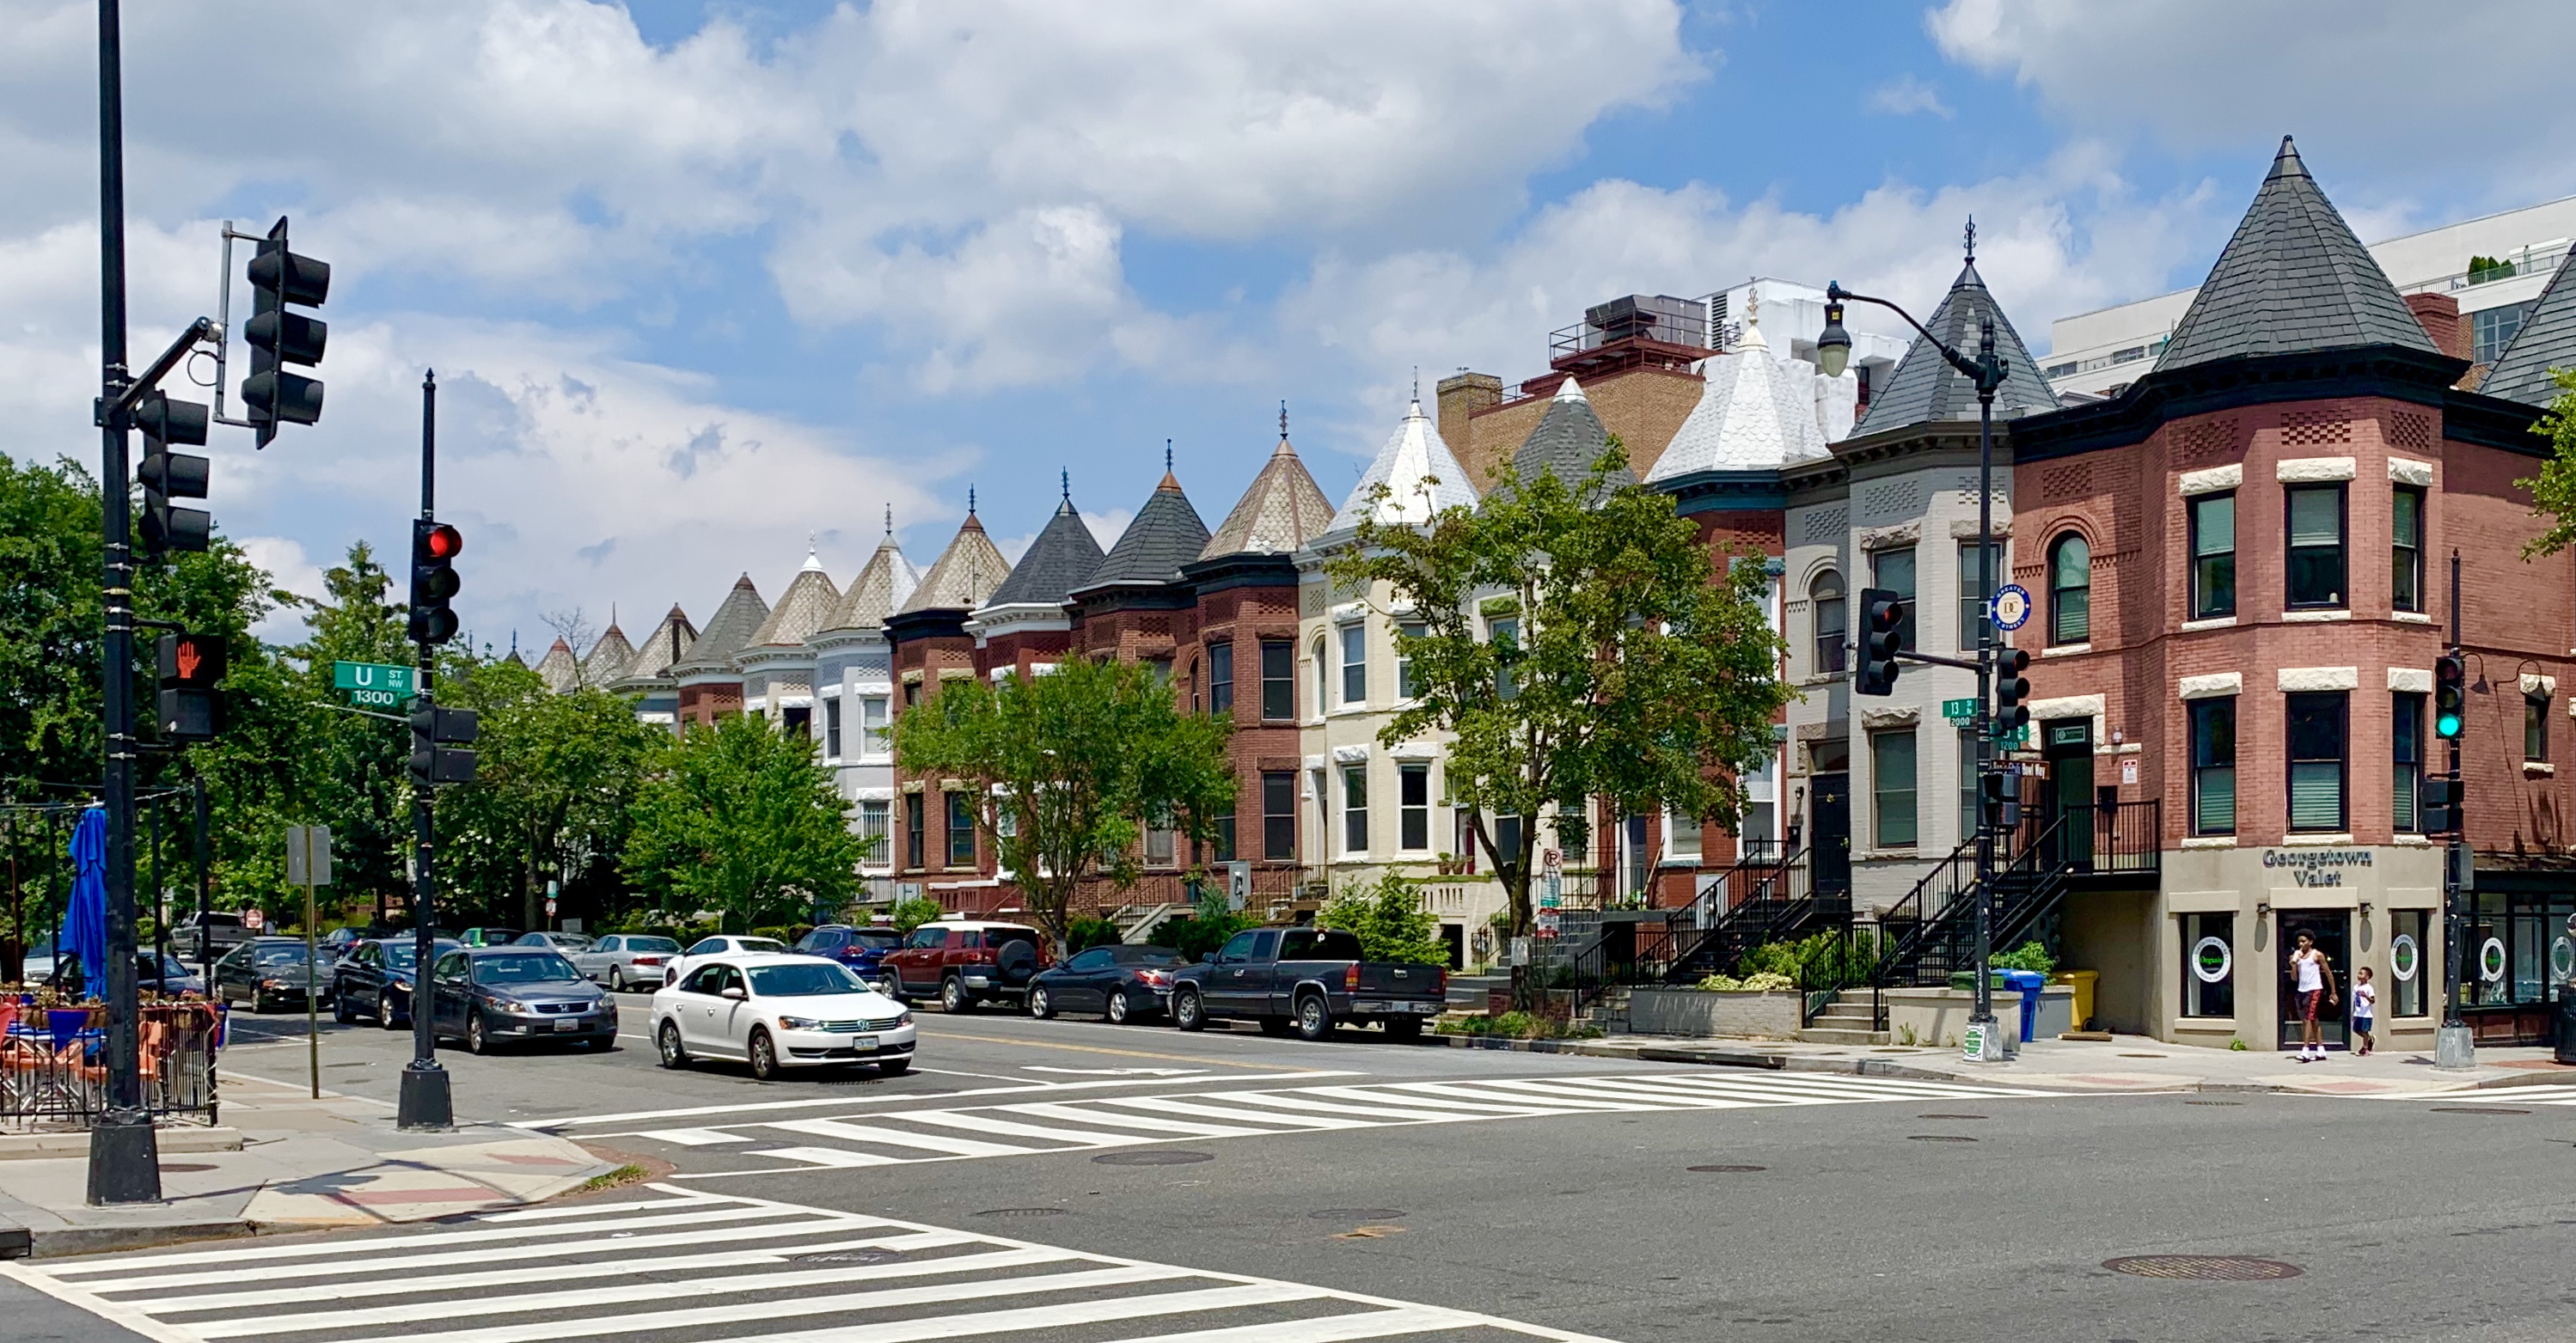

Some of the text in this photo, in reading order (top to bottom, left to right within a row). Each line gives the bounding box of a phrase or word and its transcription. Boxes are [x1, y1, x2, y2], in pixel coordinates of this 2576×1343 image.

[355, 666, 403, 687] U ST
[388, 679, 403, 688] NW
[353, 689, 395, 705] 1300
[1950, 701, 1959, 715] 13
[1950, 717, 1970, 727] 2000
[2000, 741, 2018, 751] 1200
[2262, 849, 2373, 870] Georgetown
[2293, 869, 2341, 888] Valet
